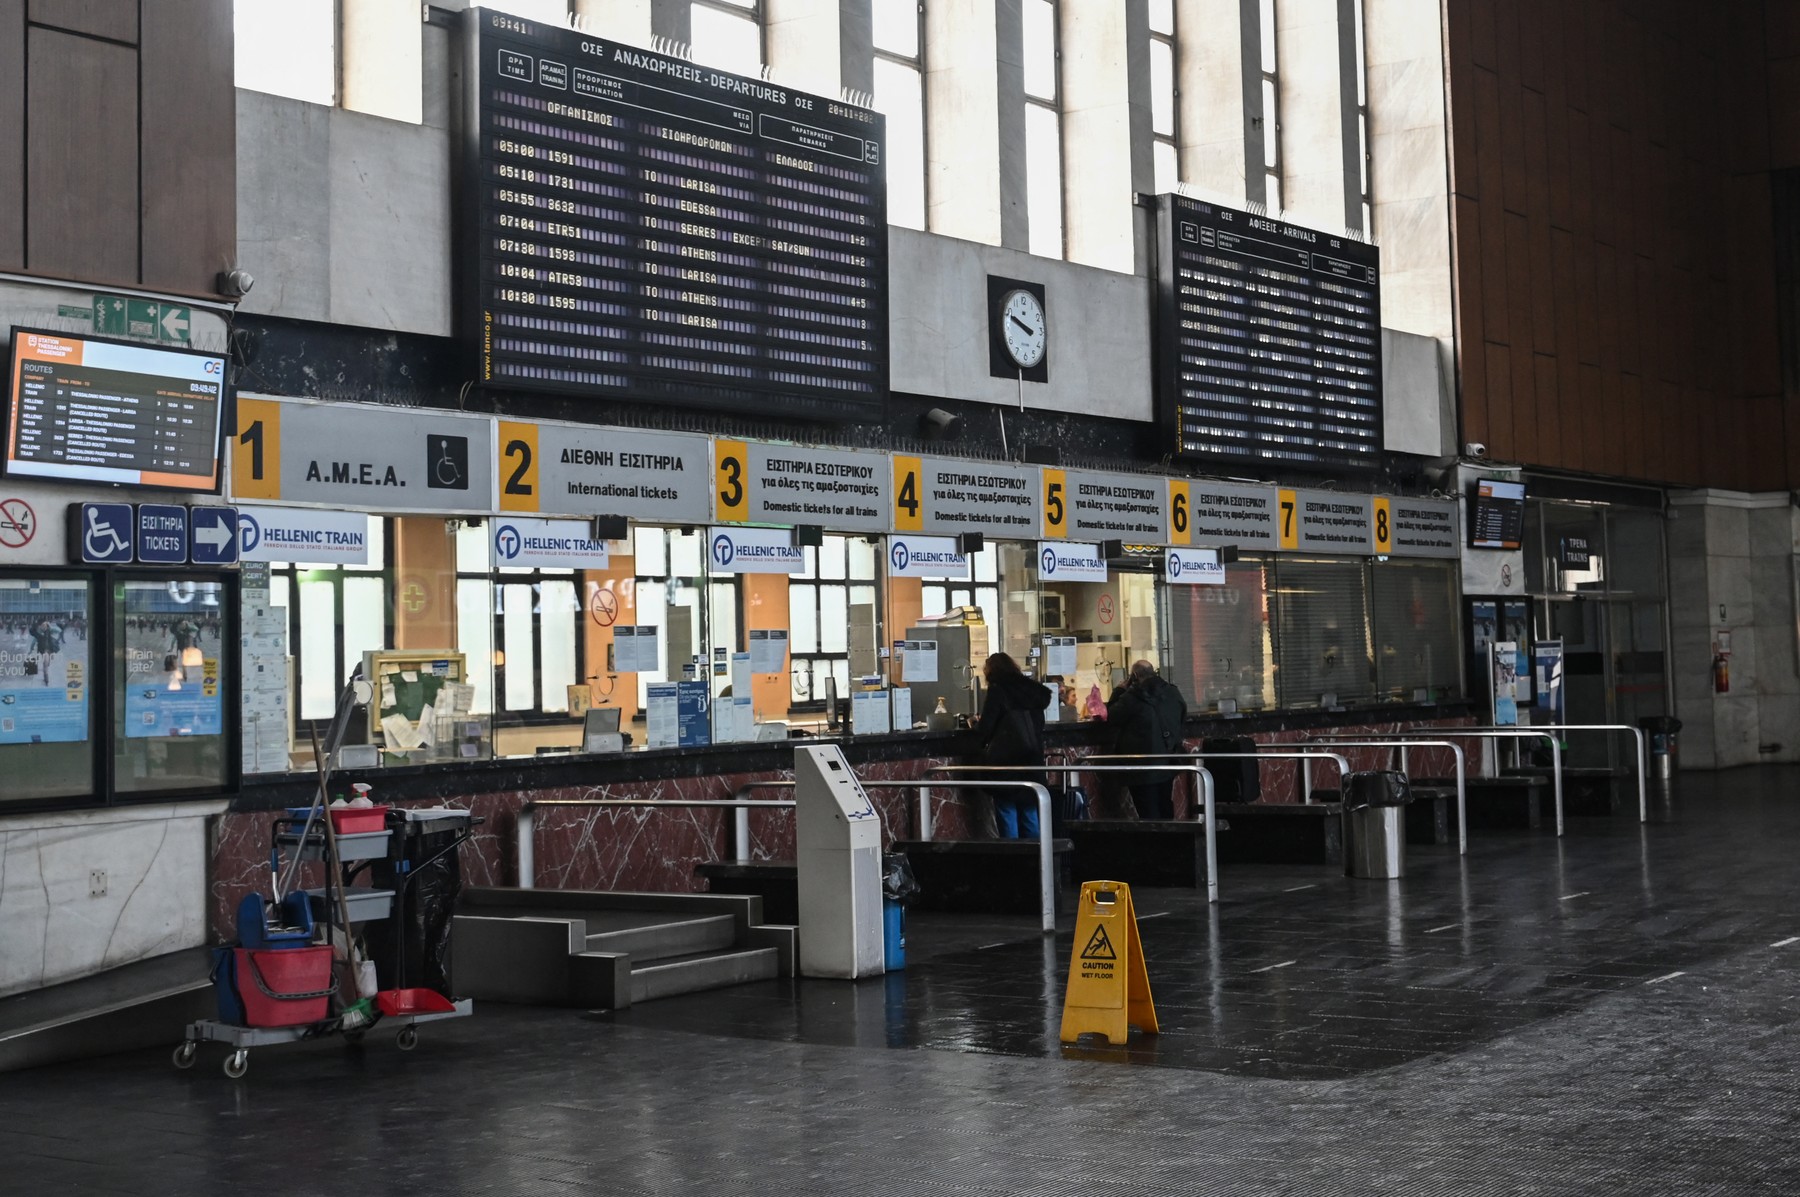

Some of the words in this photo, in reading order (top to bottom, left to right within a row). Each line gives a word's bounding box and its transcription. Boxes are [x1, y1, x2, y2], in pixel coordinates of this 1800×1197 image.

[493, 16, 527, 34] 09:41
[508, 56, 524, 65] ΩΡΑ
[507, 66, 525, 76] TIME
[581, 42, 603, 56] ΟΣΕ
[614, 49, 701, 83] ΑΝΑΧΩΡΗΣΕΙΣ
[711, 74, 786, 104] DEPARTURES
[795, 97, 813, 110] ΟΣΕ
[577, 73, 622, 89] ΠΡΟΟΡΙΣΜΟΣ
[577, 83, 623, 98] DESTINATION
[547, 101, 613, 126] ΟΡΓΑΝΙΣΜΟΣ
[662, 127, 733, 153] ΣΙΔΗΡΟΔΡΟΜΩΝ
[791, 126, 834, 142] ΠΑΡΑΤΗΡΗΣΕΙΣ
[799, 137, 826, 148] REMARKS
[500, 140, 534, 157] 05:00
[549, 150, 574, 165] 1591
[644, 170, 657, 182] TO
[681, 177, 716, 194] LARISA
[859, 215, 865, 225] 5
[500, 165, 534, 182] 05:10
[549, 174, 574, 190] 1731
[645, 193, 657, 205] TO
[681, 200, 716, 216] EDESSA
[500, 190, 534, 206] 05:55
[548, 199, 575, 213] 3632
[645, 216, 657, 228] TO
[681, 223, 716, 239] SERRES
[1221, 211, 1233, 221] ΟΣΕ
[1249, 218, 1277, 233] ΑΦΙΞΕΙΣ
[1283, 227, 1316, 243] ARRIVALS
[1330, 239, 1340, 249] ΟΣΕ
[500, 214, 534, 231] 07:04
[548, 223, 581, 239] ETR51
[645, 239, 658, 252] TO
[681, 246, 717, 261] ATHENS
[860, 278, 866, 287] 3
[500, 239, 535, 255] 07:30
[549, 247, 576, 261] 1593
[645, 262, 658, 275] TO
[681, 268, 717, 284] LARISA
[501, 264, 535, 280] 10:04
[549, 272, 582, 287] ATR53
[645, 285, 658, 298] TO
[681, 292, 717, 306] ATHENS
[861, 319, 867, 329] 3
[501, 289, 535, 304] 10:30
[549, 296, 576, 310] 1595
[646, 309, 658, 321] TO
[682, 315, 718, 329] LARISA
[861, 340, 867, 350] 5
[24, 363, 53, 374] ROUTES
[240, 420, 263, 480] 1
[505, 439, 532, 495] 2
[560, 448, 614, 467] ΔΙΕΘΝΗ
[620, 453, 684, 471] ΕΙΣΙΤΗΡΙΑ
[306, 460, 406, 487] Α.Μ.Ε.Α.
[767, 458, 813, 474] ΕΙΣΙΤΗΡΙΑ
[815, 463, 873, 479] ΕΣΩΤΕΡΙΚΟΥ
[568, 481, 638, 498] International
[641, 485, 678, 499] tickets
[720, 457, 743, 507] 3
[761, 477, 776, 490] για
[778, 477, 800, 491] όλες
[801, 480, 815, 492] τις
[816, 480, 879, 496] αμαξοστοιχίες
[937, 473, 976, 487] ΕΙΣΙΤΗΡΙΑ
[978, 475, 1026, 490] ΕΣΩΤΕΡΙΚΟΥ
[898, 471, 919, 517] 4
[933, 489, 946, 500] για
[947, 489, 965, 502] όλες
[966, 491, 978, 502] τις
[979, 492, 1031, 506] αμαξοστοιχίες
[1079, 484, 1112, 497] ΕΙΣΙΤΗΡΙΑ
[1113, 487, 1155, 500] ΕΣΩΤΕΡΙΚΟΥ
[763, 500, 802, 513] Domestic
[804, 502, 831, 515] tickets
[832, 504, 844, 515] for
[845, 505, 855, 515] all
[856, 505, 878, 517] trains
[1047, 483, 1063, 525] 5
[935, 511, 967, 522] Domestic
[968, 512, 992, 523] tickets
[992, 513, 1002, 523] for
[1003, 514, 1011, 524] all
[1012, 514, 1031, 525] trains
[1172, 493, 1187, 533] 6
[1281, 502, 1293, 537] 7
[1077, 519, 1105, 530] Domestic
[1106, 520, 1125, 531] tickets
[1126, 522, 1134, 531] for
[1143, 523, 1158, 532] trains
[1377, 508, 1388, 543] 8
[145, 536, 180, 551] TICKETS
[264, 528, 322, 543] HELLENIC
[325, 531, 363, 545] TRAIN
[524, 537, 571, 550] HELLENIC
[573, 539, 604, 551] TRAIN
[1569, 538, 1587, 549] ΤΡΕΝΑ
[736, 545, 775, 557] HELLENIC
[776, 546, 802, 558] TRAIN
[911, 552, 943, 562] HELLENIC
[944, 553, 966, 563] TRAIN
[1567, 552, 1588, 563] TRAINS
[246, 562, 263, 570] EURO
[1057, 557, 1085, 567] HELLENIC
[1086, 558, 1104, 568] TRAIN
[1182, 562, 1206, 570] HELLENIC
[1207, 562, 1222, 571] TRAIN
[247, 572, 263, 580] CERT
[129, 648, 153, 660] Train
[129, 661, 154, 672] late?
[1082, 962, 1114, 970] CAUTION
